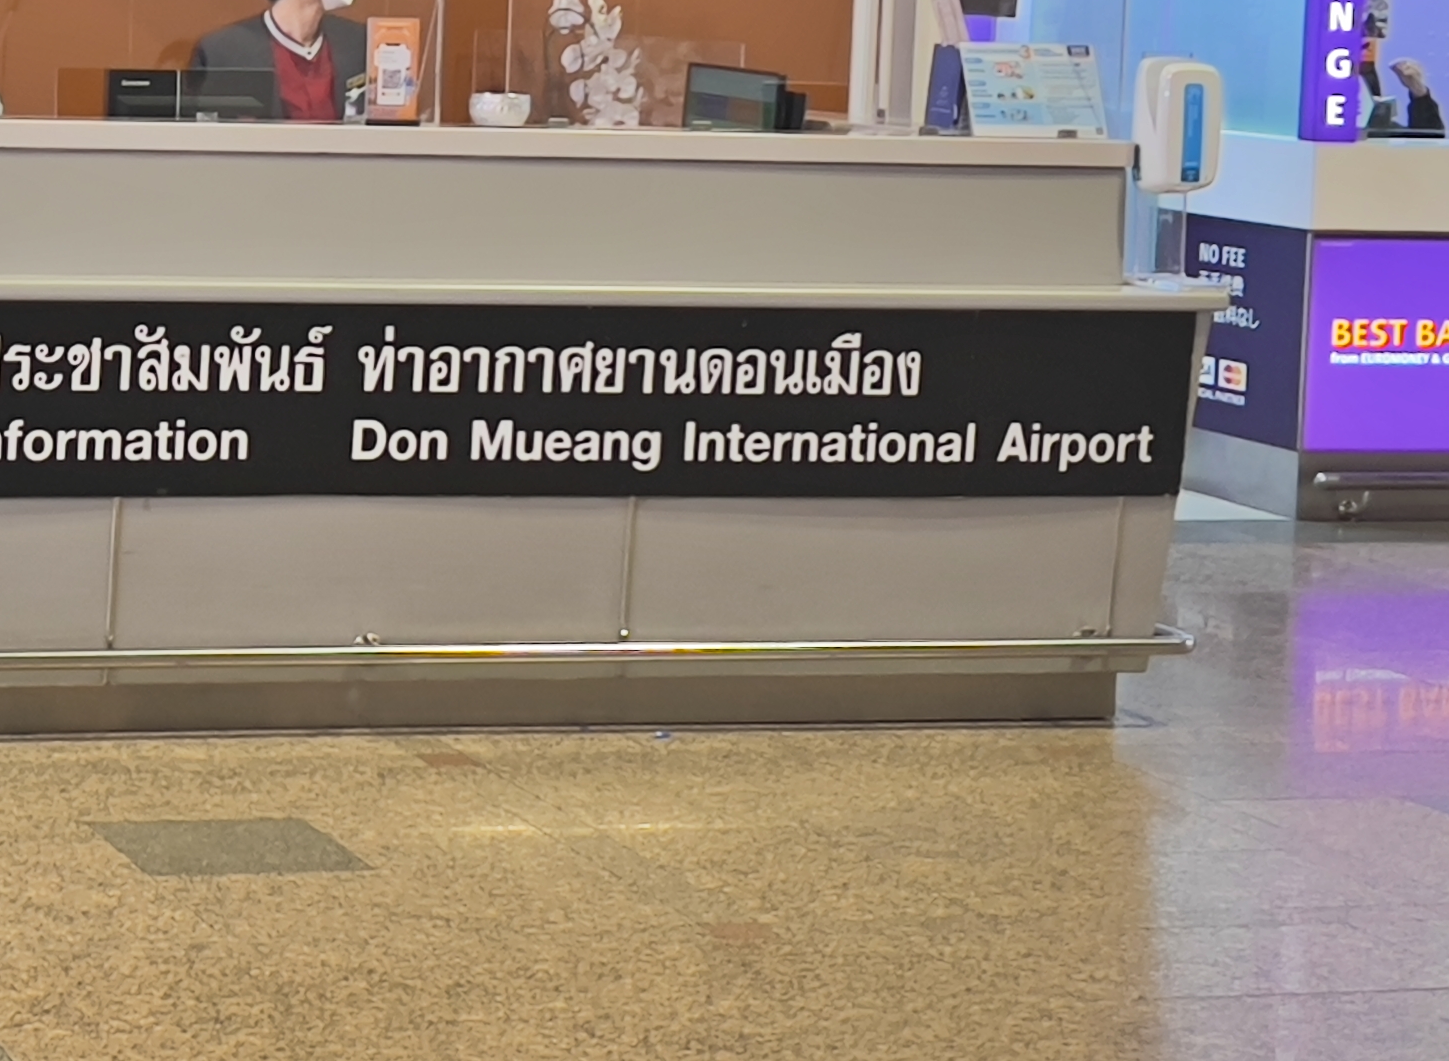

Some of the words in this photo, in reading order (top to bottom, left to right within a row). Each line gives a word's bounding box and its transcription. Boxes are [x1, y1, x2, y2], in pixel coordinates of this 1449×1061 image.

[1198, 242, 1220, 264] NO
[1221, 246, 1246, 269] FEE
[1331, 318, 1409, 349] BEST
[356, 324, 922, 397] ท่าอากาศยานดอนเมือง
[350, 418, 449, 462] Don
[469, 419, 663, 473] Mueang
[682, 420, 977, 464] International
[995, 422, 1155, 473] Airport
